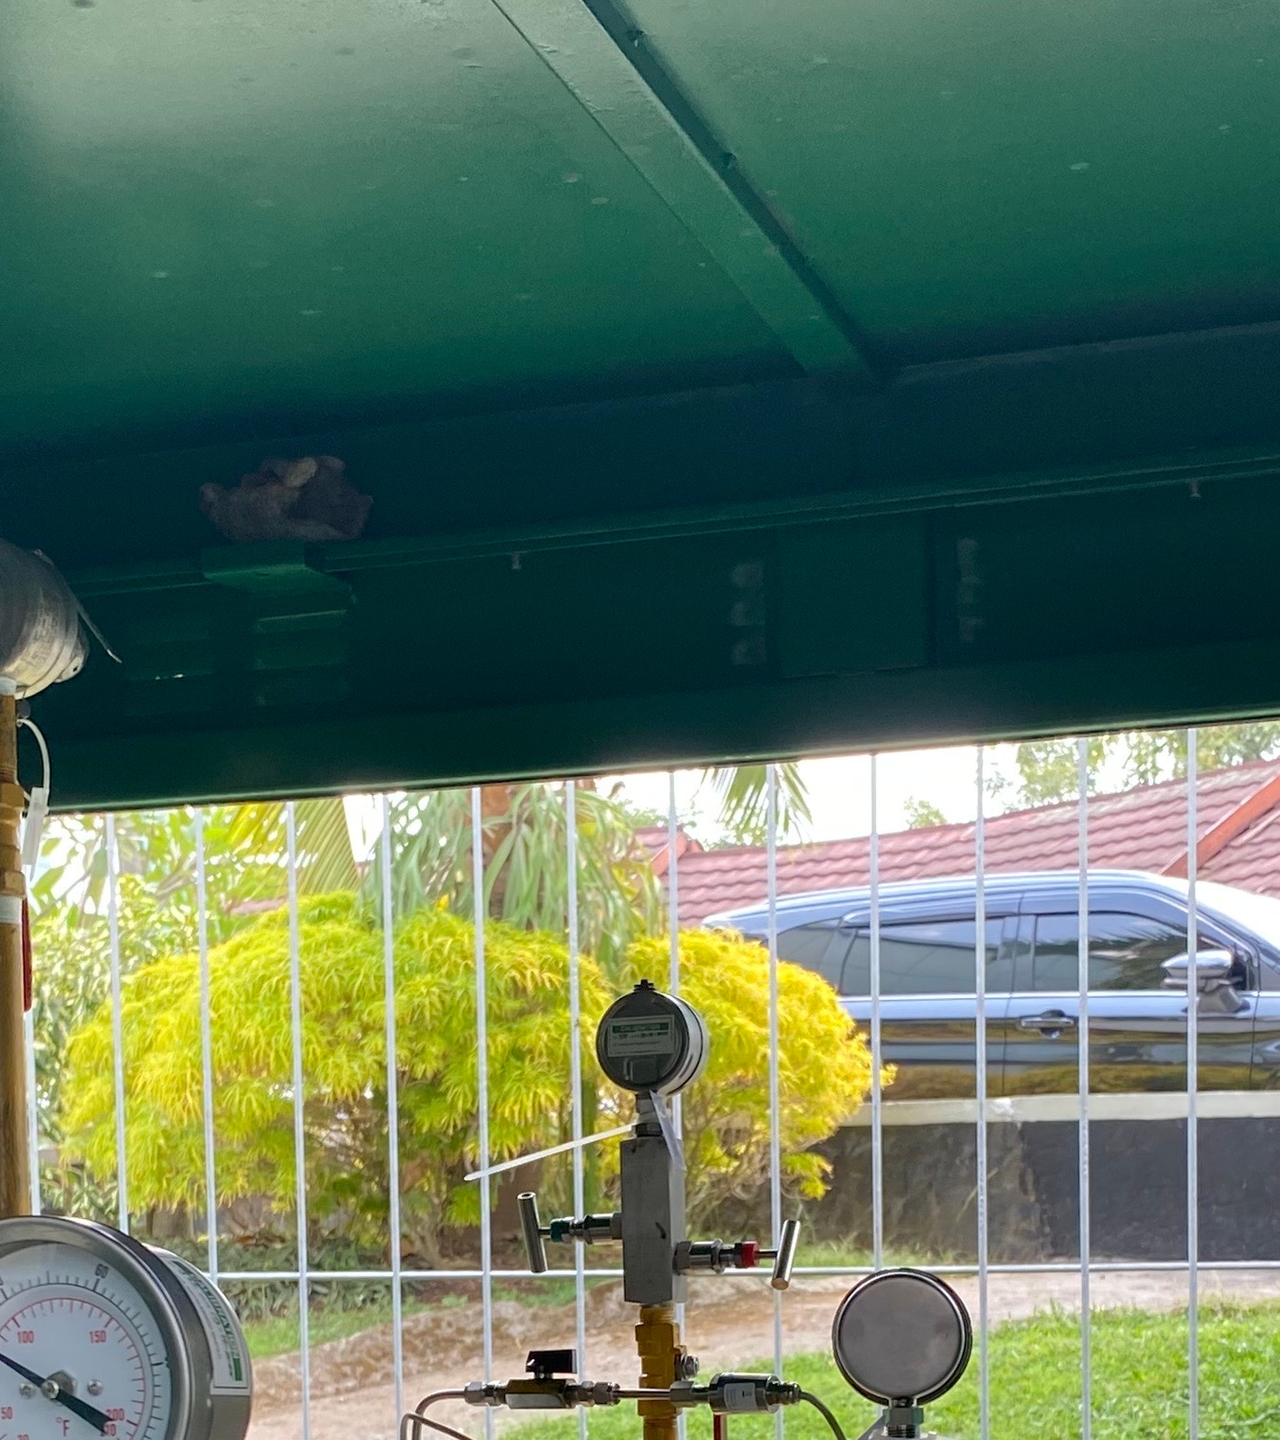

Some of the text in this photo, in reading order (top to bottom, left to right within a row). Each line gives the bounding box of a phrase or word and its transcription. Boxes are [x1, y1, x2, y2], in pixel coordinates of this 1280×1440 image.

[94, 1262, 110, 1280] 60
[17, 1330, 35, 1344] 100
[89, 1330, 107, 1344] 150
[0, 1406, 13, 1421] 50
